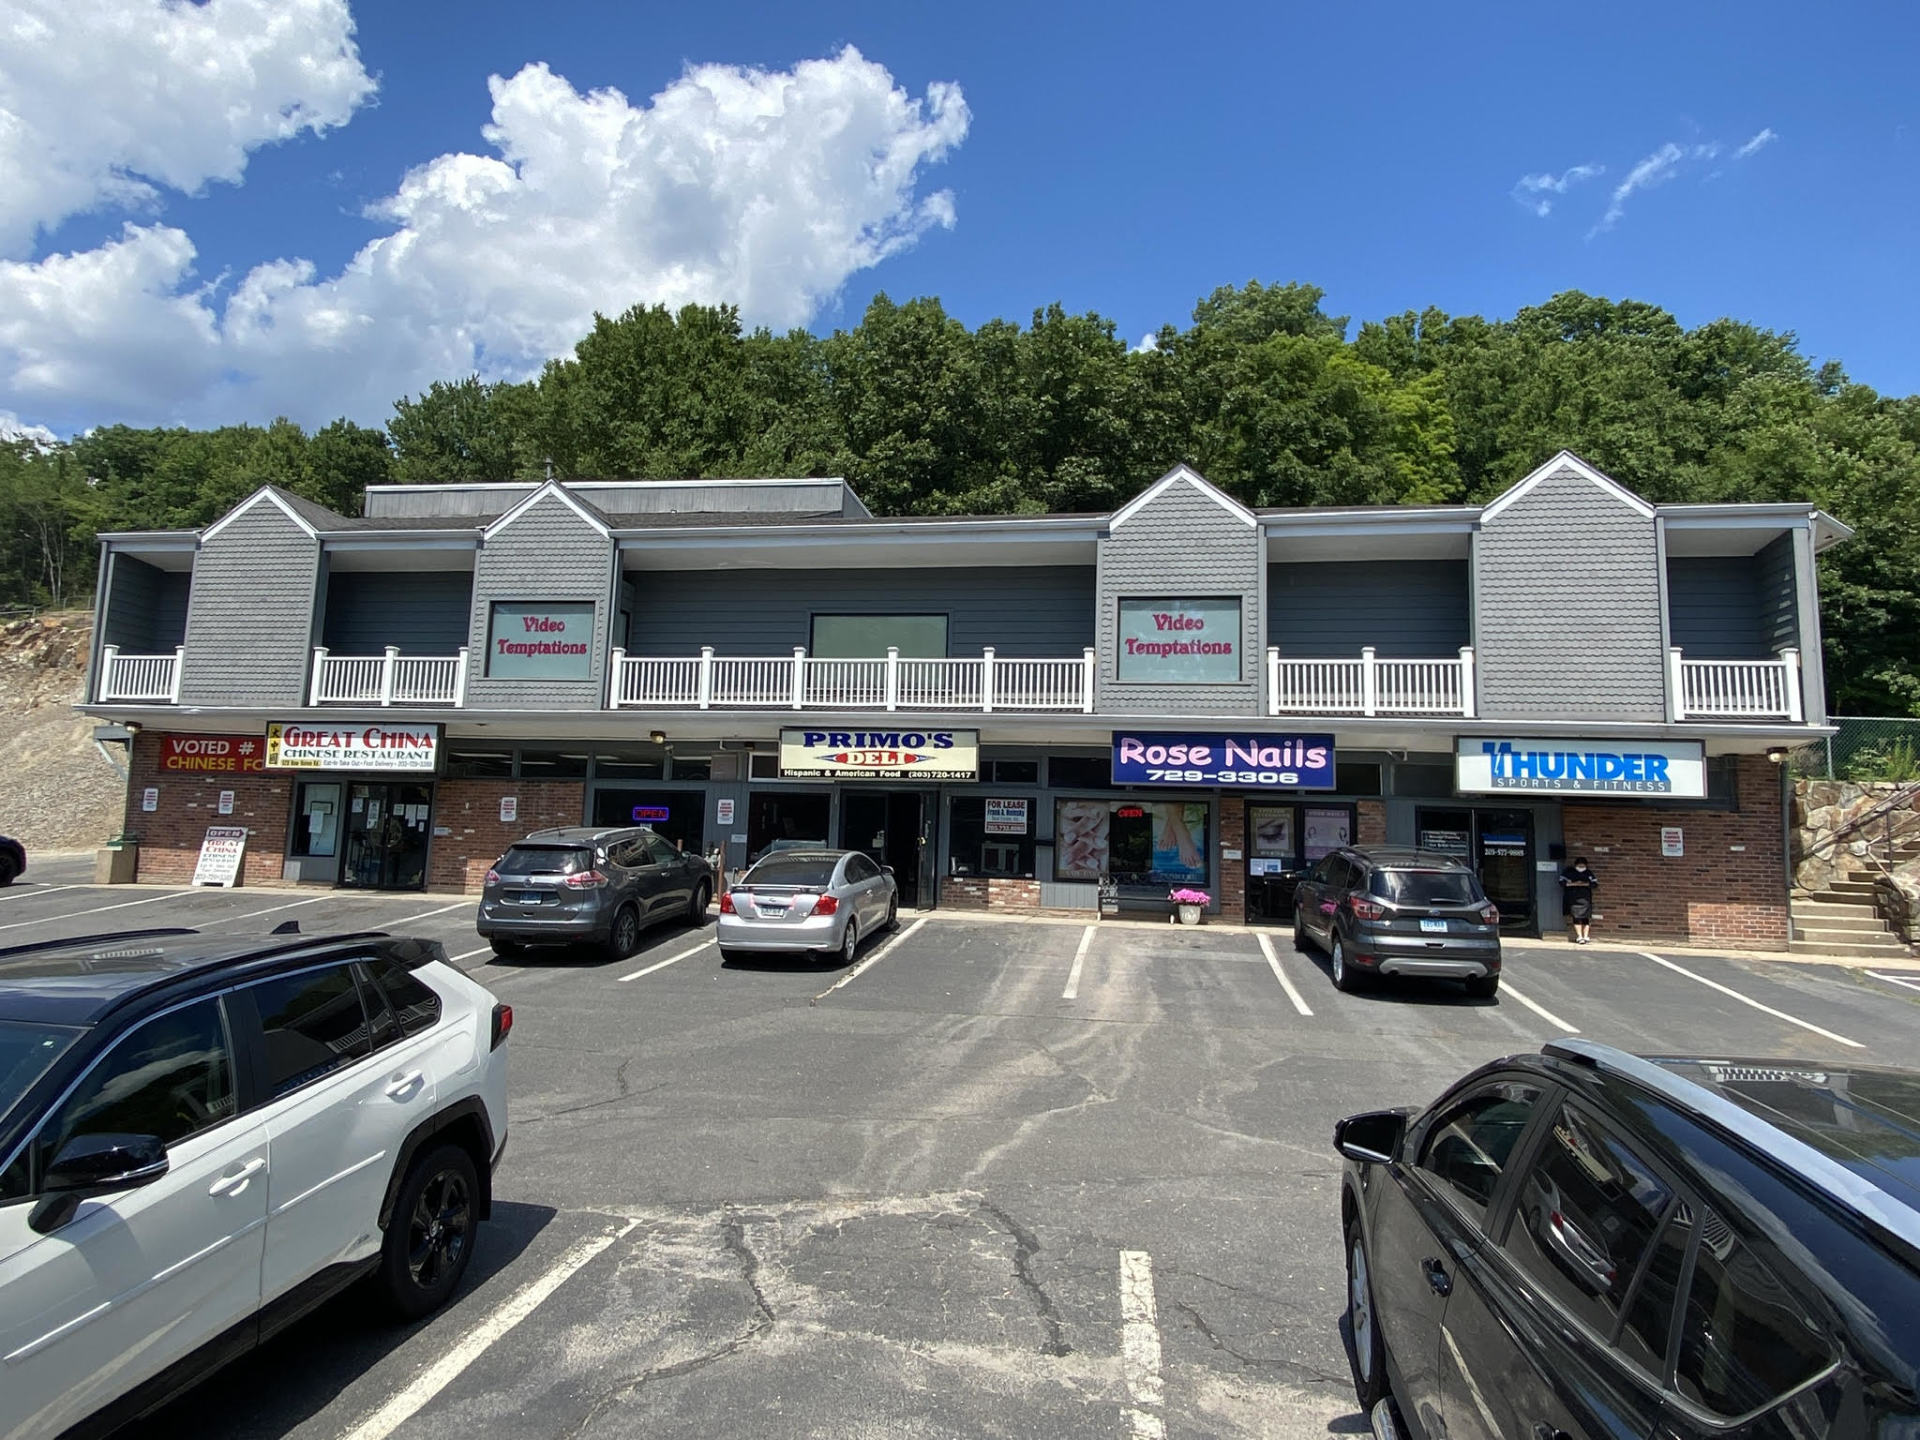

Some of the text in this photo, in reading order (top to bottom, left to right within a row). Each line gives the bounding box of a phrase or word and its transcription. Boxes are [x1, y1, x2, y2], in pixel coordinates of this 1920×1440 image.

[523, 616, 565, 632] Video
[1153, 614, 1204, 630] Video
[498, 639, 587, 657] Temptations
[1125, 638, 1232, 658] Temptations
[284, 726, 433, 749] GREAT CHINA
[803, 732, 954, 749] PRIMO'S
[172, 740, 255, 755] VOTED #
[284, 750, 431, 760] CHINESE RESTAURANT
[1120, 738, 1327, 768] Rose Nails
[167, 756, 265, 771] CHINESE FO
[375, 761, 393, 769] Delivery
[847, 752, 905, 765] DELI
[1482, 742, 1670, 781] THUNDER
[784, 769, 821, 778] Hispanic
[835, 770, 875, 778] American
[1146, 769, 1299, 783] 729-3306
[1497, 778, 1665, 791] SPORTS & FITNESS
[988, 800, 1001, 808] FOR
[636, 810, 666, 818] OPEN
[1117, 809, 1143, 818] OPEN
